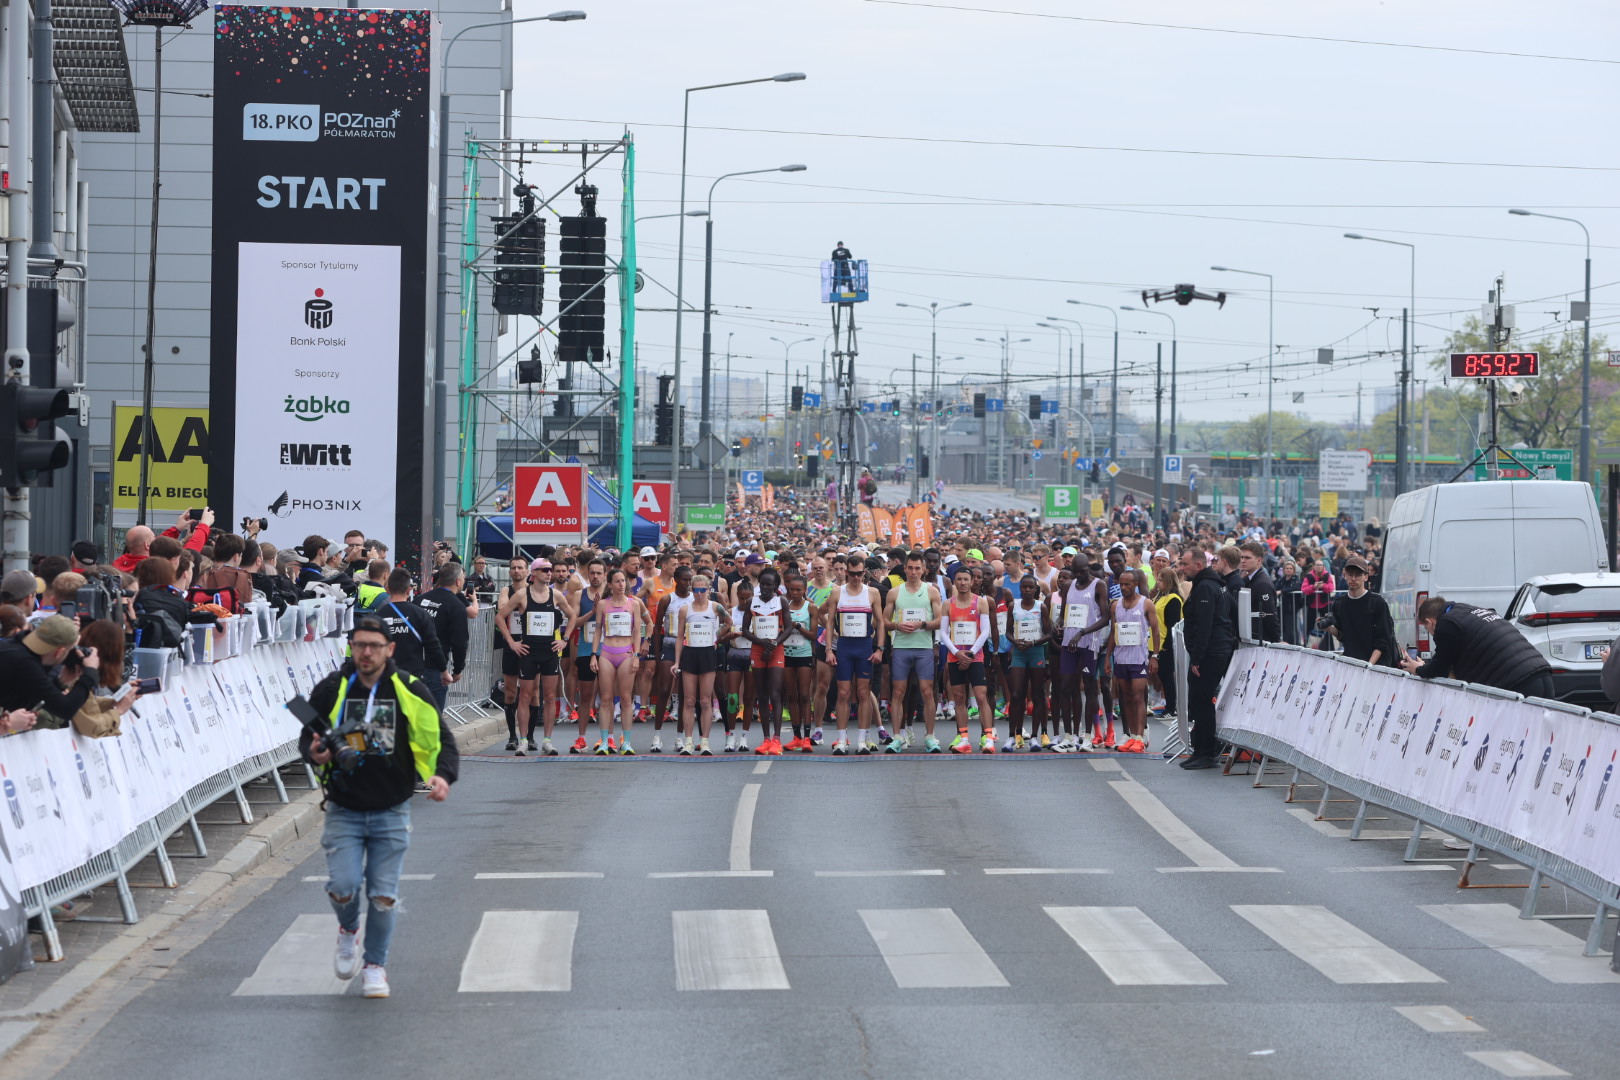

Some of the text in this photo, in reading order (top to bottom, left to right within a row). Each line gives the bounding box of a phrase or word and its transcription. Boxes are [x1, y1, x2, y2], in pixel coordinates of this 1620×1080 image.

[324, 128, 396, 138] PÓŁMARATON
[256, 175, 386, 210] START
[281, 260, 359, 271] Sponsor Tytularny
[290, 336, 346, 347] Bank Polski
[294, 368, 340, 379] Sponsorzy
[284, 394, 350, 414] żabka
[1516, 451, 1539, 461] Nowy
[1168, 458, 1178, 470] P
[746, 472, 758, 484] C
[527, 471, 571, 507] A
[633, 485, 662, 513] A
[1053, 489, 1071, 507] B
[520, 517, 578, 527] Poniżej 1:30
[651, 520, 667, 528] :30
[389, 625, 409, 635] EAM
